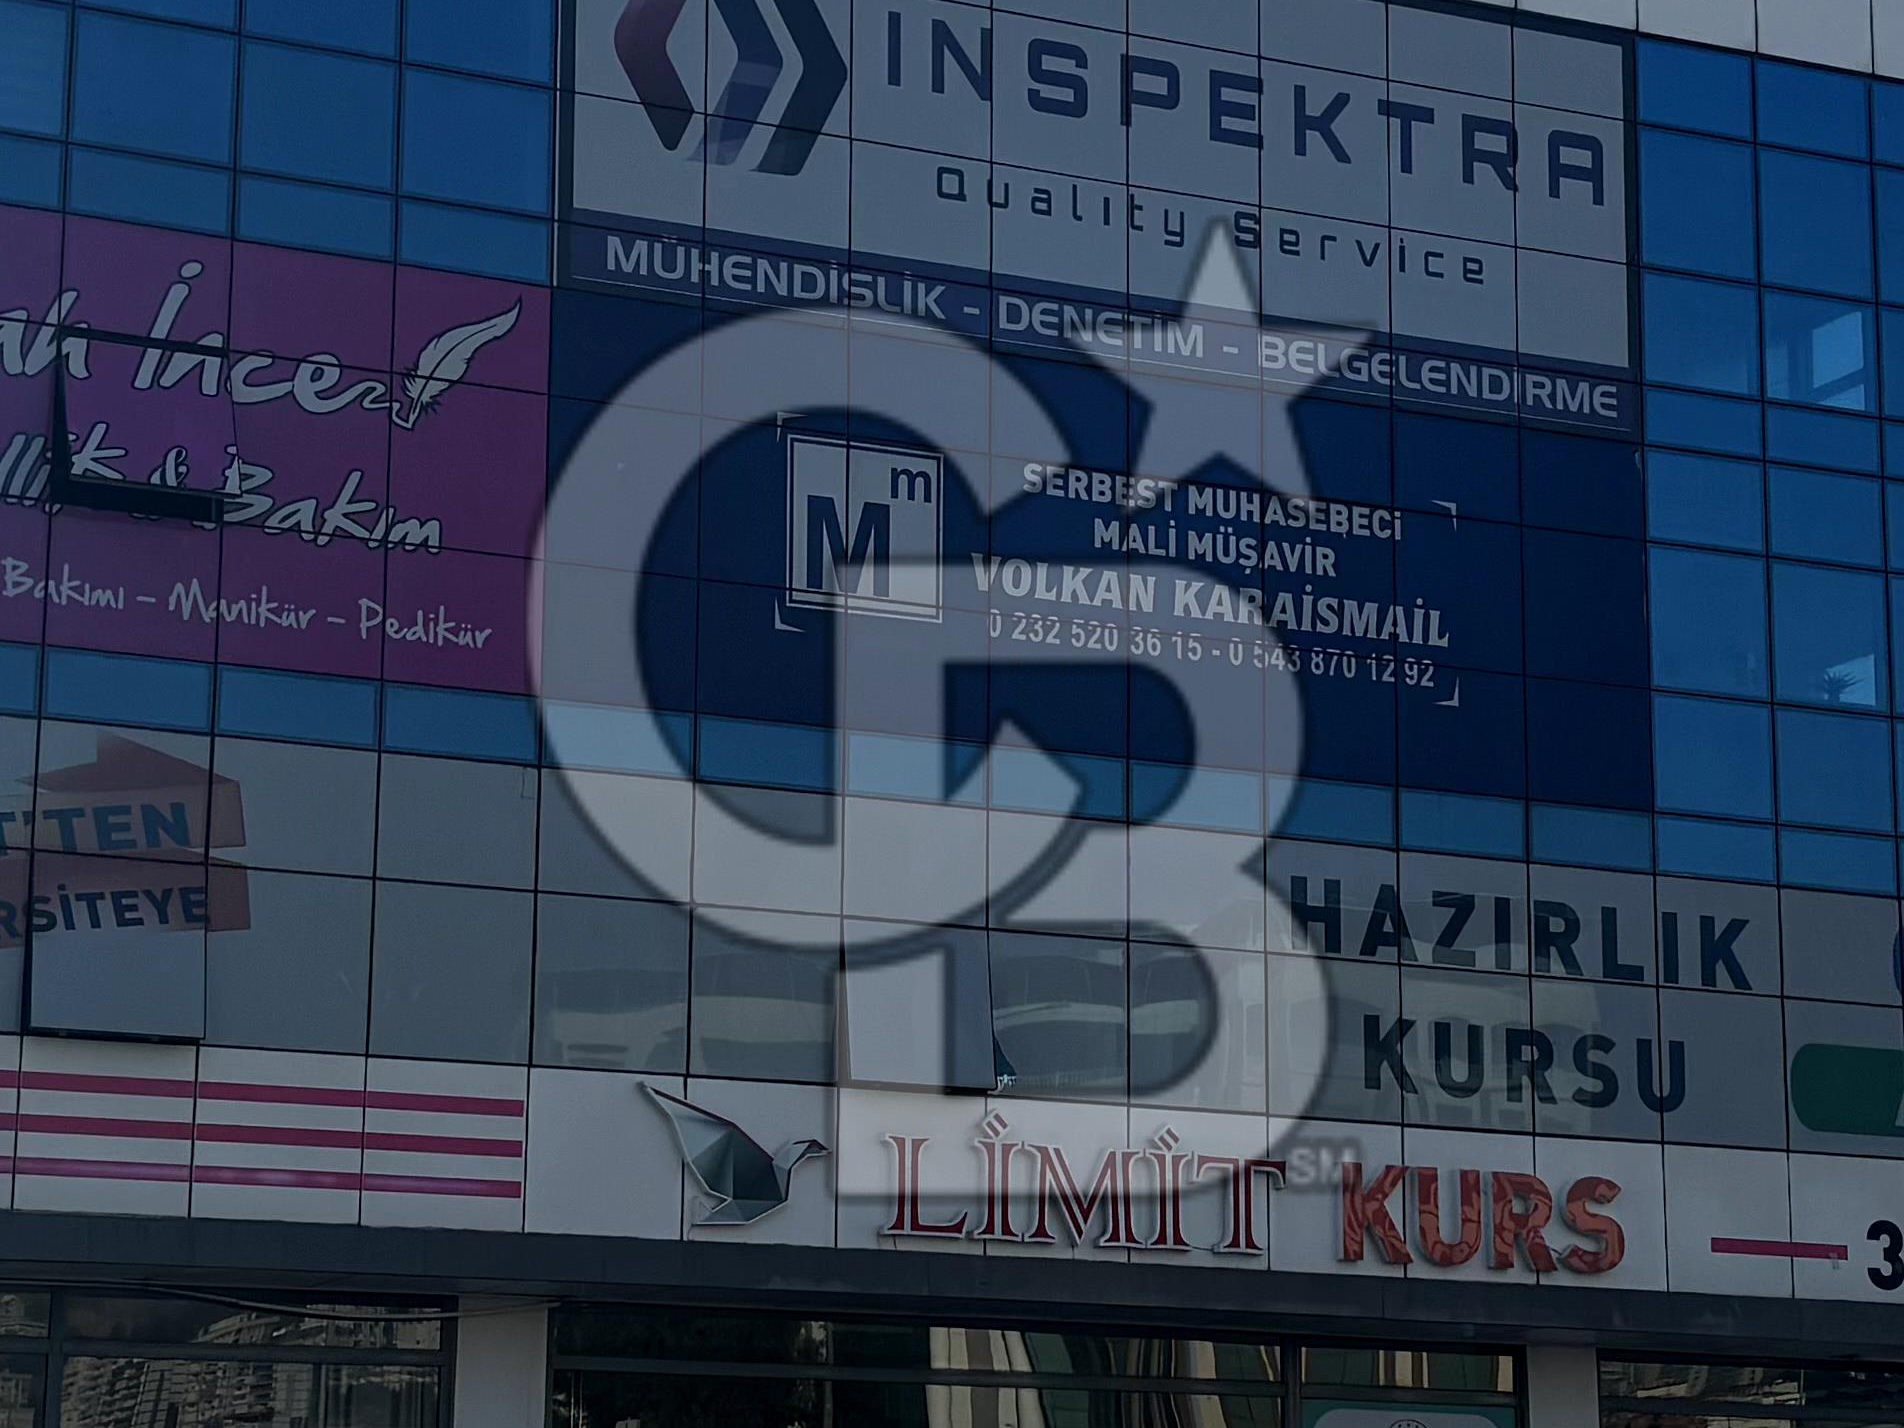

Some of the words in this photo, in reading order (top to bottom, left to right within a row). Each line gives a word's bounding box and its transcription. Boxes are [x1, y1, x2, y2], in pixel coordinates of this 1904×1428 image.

[888, 11, 1604, 206] INSPEKTRA
[938, 167, 1186, 247] Quality
[1234, 210, 1484, 285] Service
[132, 261, 354, 414] İnce
[607, 233, 946, 320] MÜHENDİSLİK
[999, 296, 1204, 360] DENETİM
[1260, 332, 1618, 418] BELGELENDİRME
[213, 445, 442, 555] Bakım
[1022, 463, 1177, 514] SERBEST
[2, 554, 125, 610] Bakımı
[169, 582, 315, 631] Manikür
[360, 599, 492, 650] Pedikür
[970, 552, 1155, 613] VOLKAN
[1173, 579, 1450, 648] KARAİSMAİL
[1093, 518, 1177, 557] MALİ
[1187, 528, 1337, 577] MÜŞAVİR
[987, 609, 999, 636] 0
[1012, 612, 1060, 644] 232
[1071, 621, 1118, 652] 520
[1130, 626, 1161, 656] 36
[1172, 631, 1202, 661] 15
[1310, 647, 1356, 678] 870
[1366, 653, 1395, 682] 12
[1404, 656, 1434, 686] 92
[1292, 875, 1752, 992] HAZIRLIK
[1364, 1014, 1686, 1114] KURSU
[884, 1108, 1286, 1255] LİMİT
[1340, 1162, 1625, 1274] KURS
